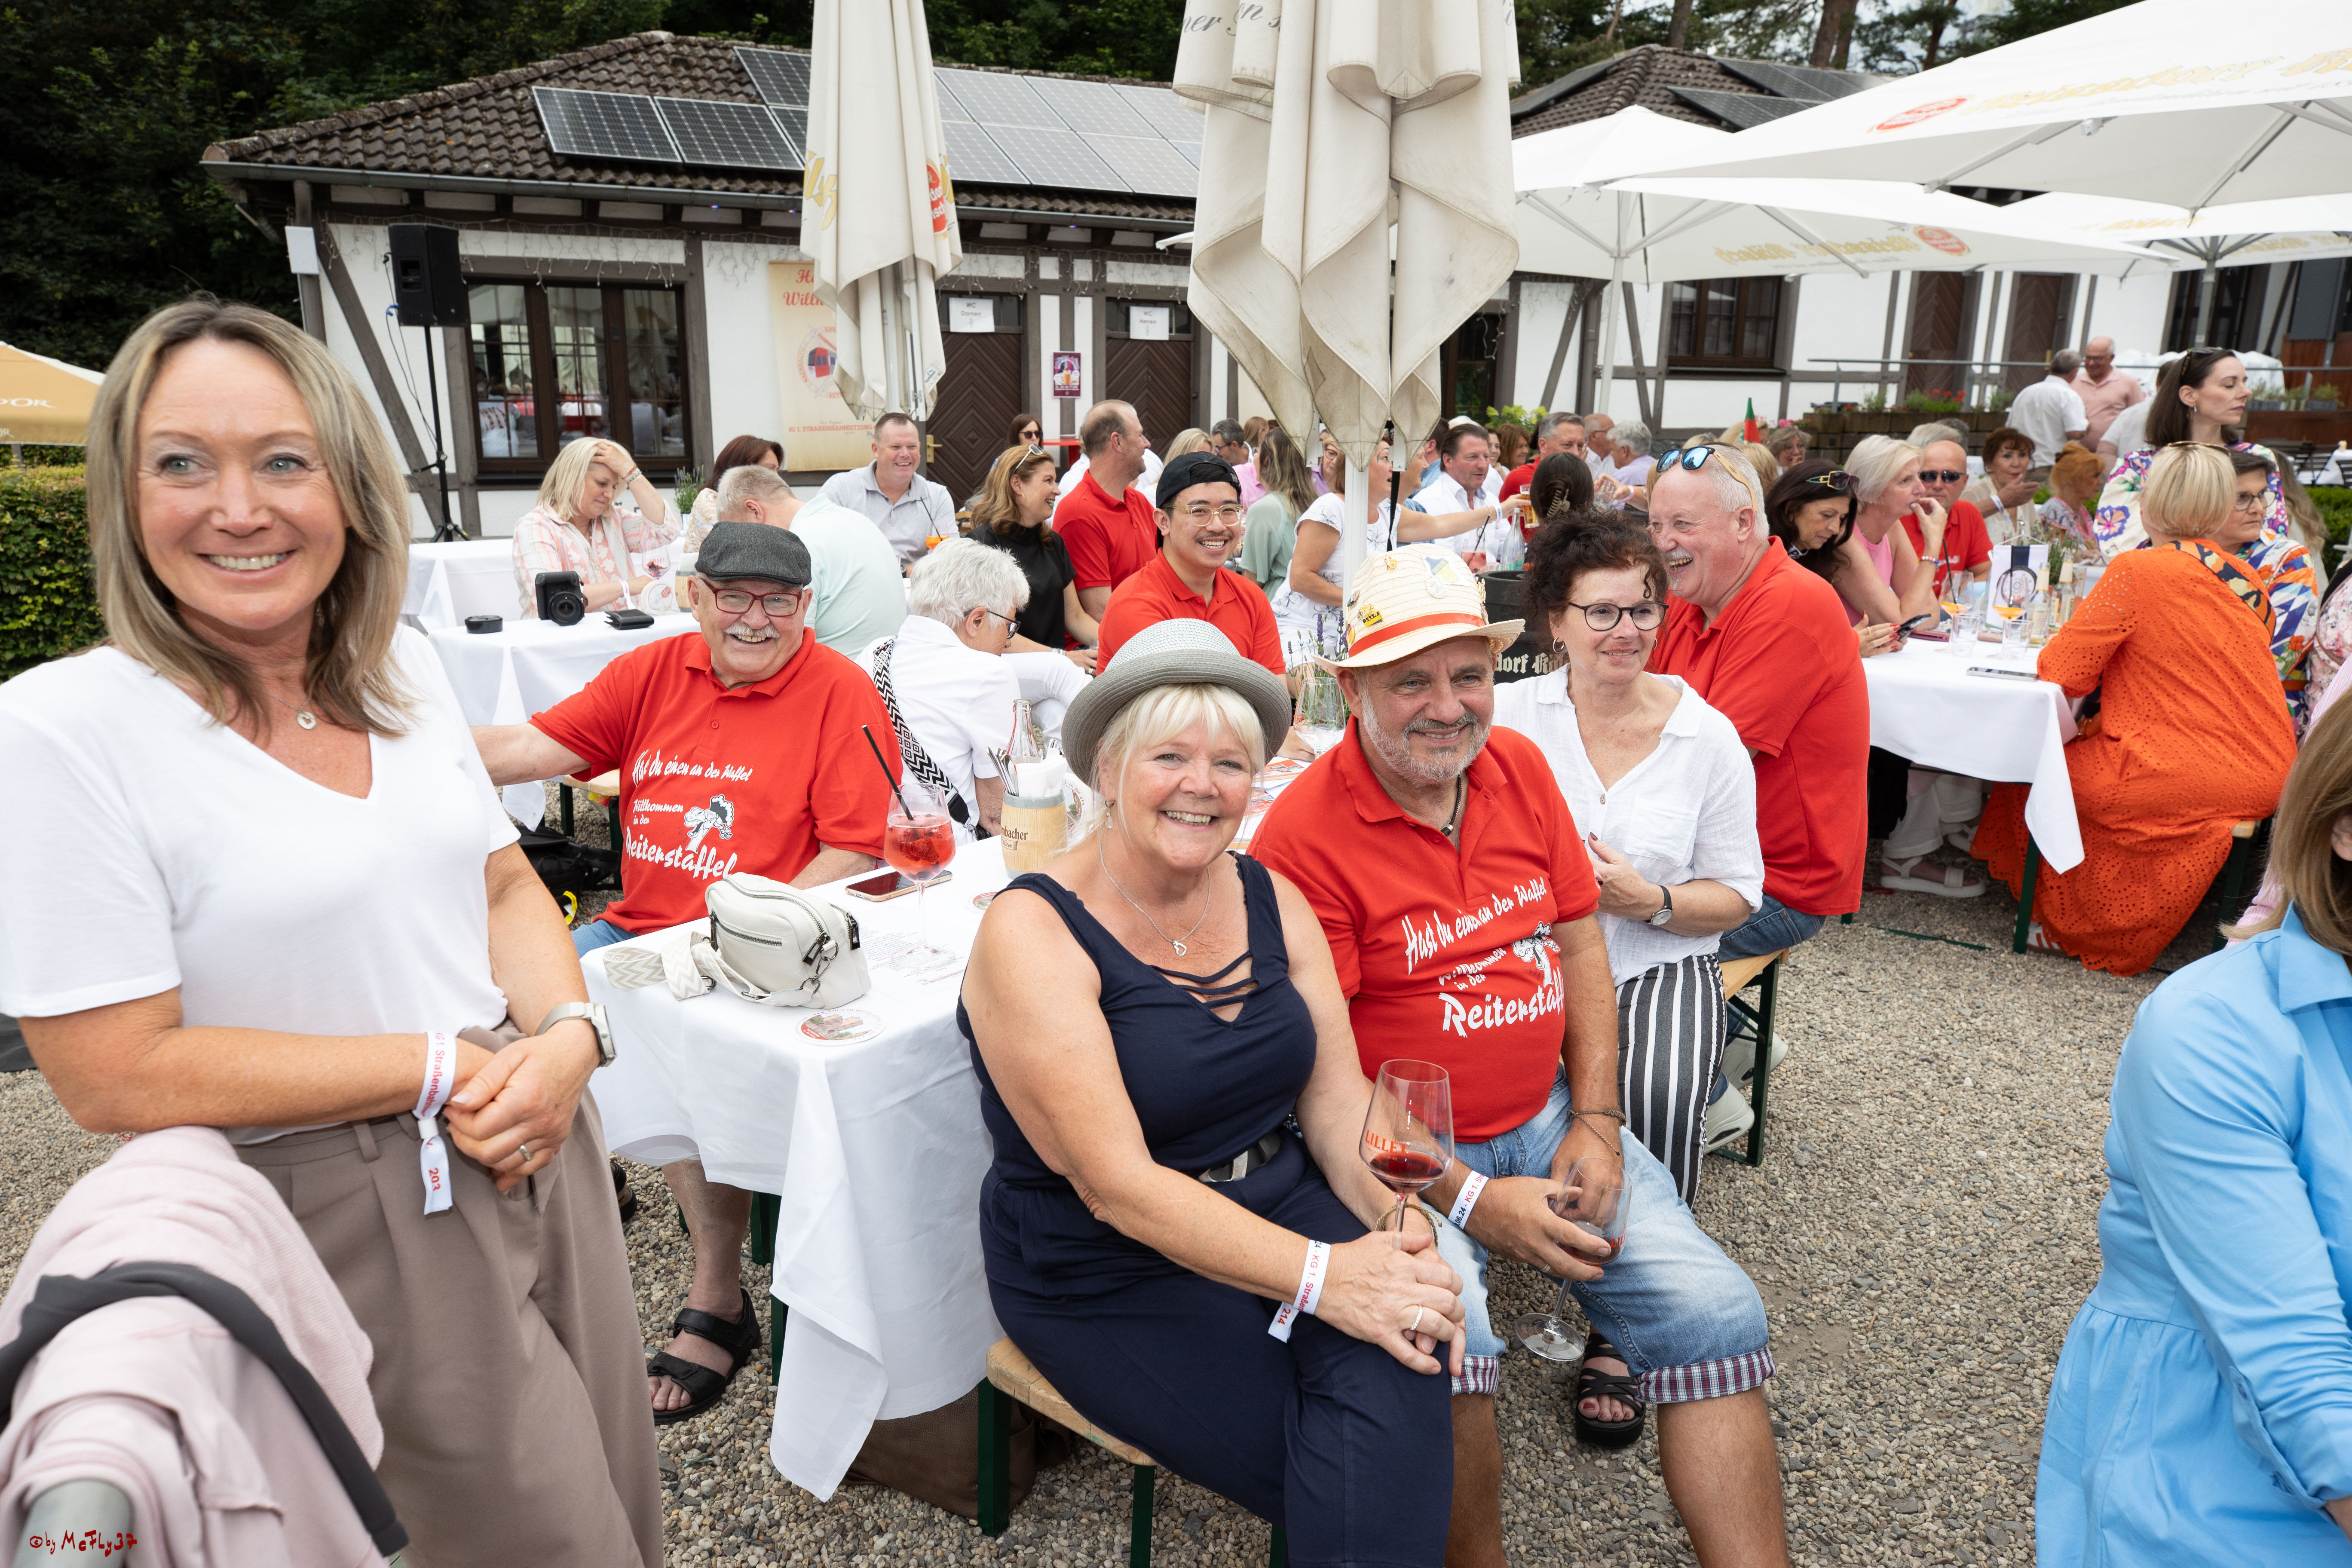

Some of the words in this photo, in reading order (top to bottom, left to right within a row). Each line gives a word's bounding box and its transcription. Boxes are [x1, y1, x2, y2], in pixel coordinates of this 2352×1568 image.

[664, 755, 689, 776] einen
[689, 764, 703, 776] an
[704, 761, 720, 778] der
[720, 763, 753, 782] Waffel
[632, 798, 684, 814] Willkommen
[633, 815, 639, 825] in
[639, 813, 650, 825] der
[626, 825, 738, 880] Reiterstaffel
[1401, 914, 1438, 976] Hast
[1478, 906, 1494, 926] an
[1491, 893, 1515, 916] der
[1513, 876, 1547, 908] Waffel
[1438, 947, 1507, 986] Willkommen
[1454, 981, 1468, 991] in
[1467, 973, 1487, 986] der
[1365, 1129, 1412, 1156] LILLET
[428, 1167, 441, 1192] 203
[1464, 1191, 1474, 1203] KG
[1310, 1254, 1320, 1268] KG
[1277, 1308, 1291, 1325] 214
